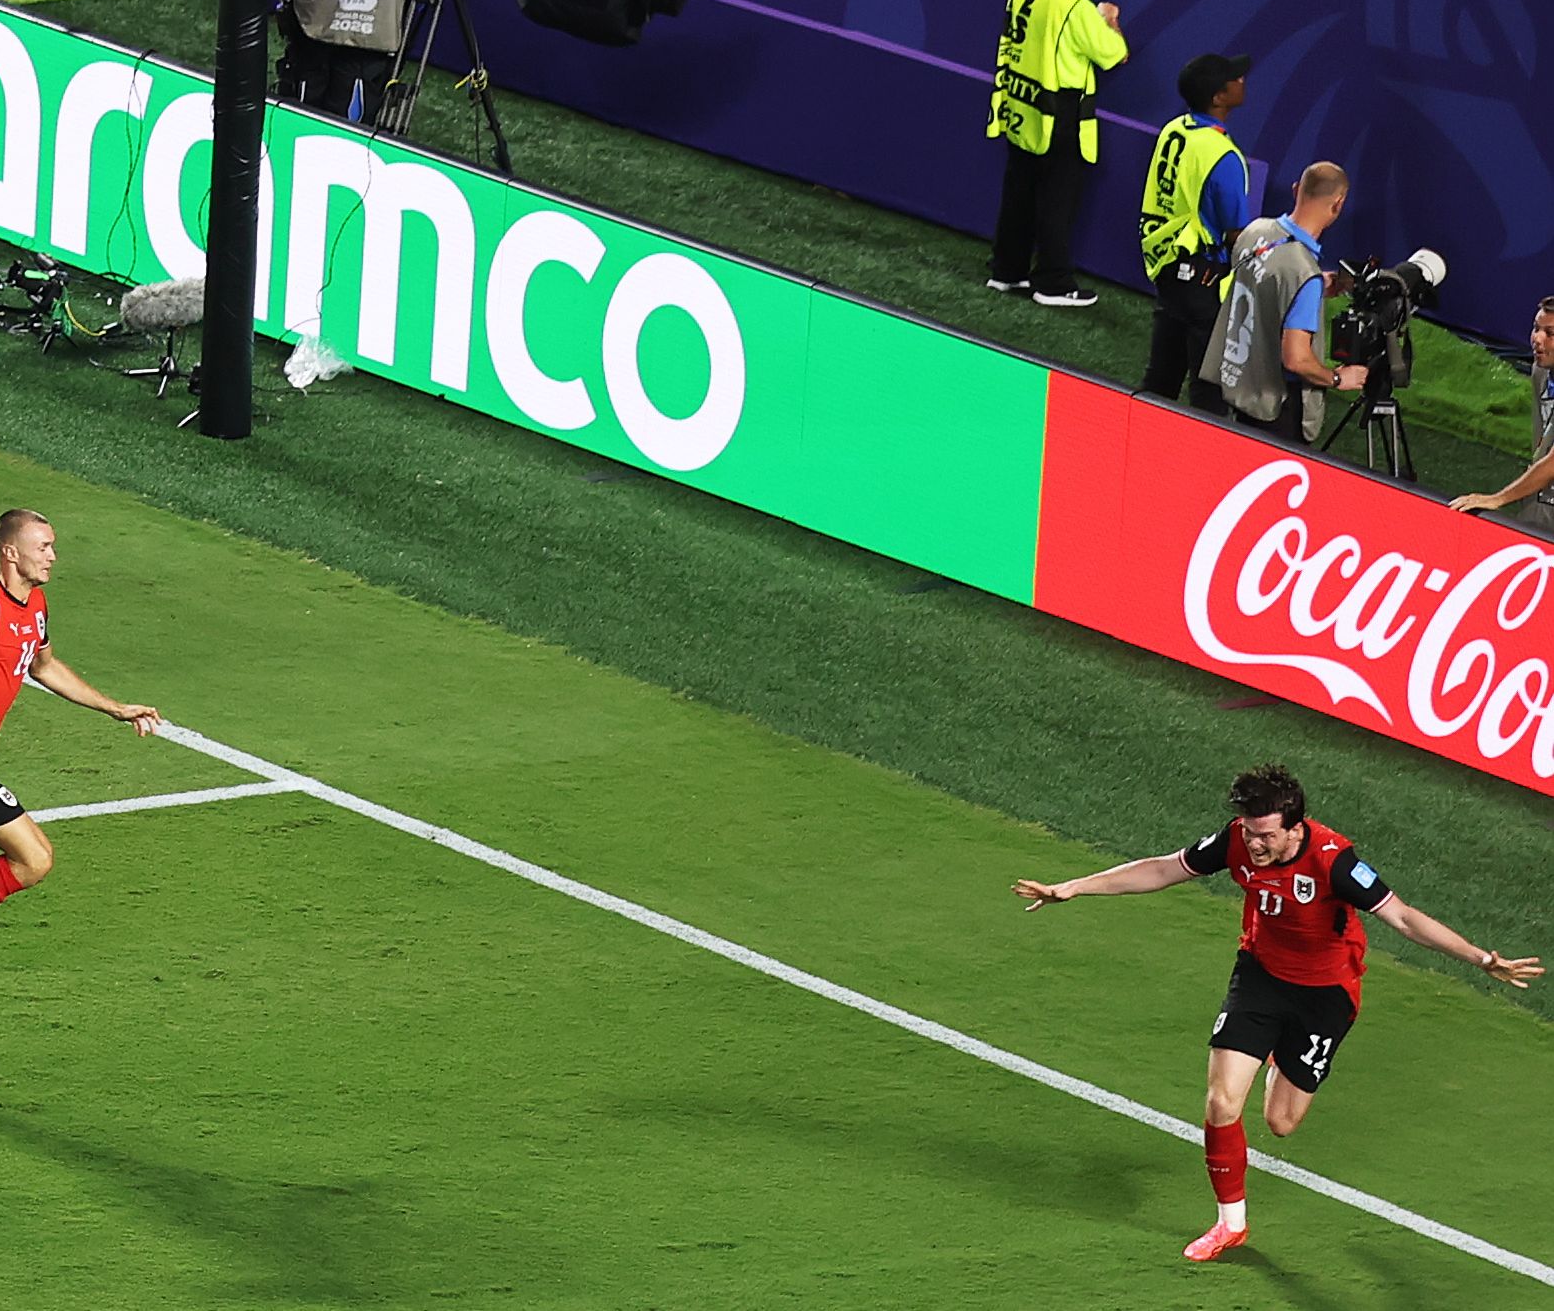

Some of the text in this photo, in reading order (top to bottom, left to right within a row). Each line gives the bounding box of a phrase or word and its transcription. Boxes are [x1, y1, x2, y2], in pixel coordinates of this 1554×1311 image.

[329, 19, 375, 35] 2026
[1184, 459, 1554, 779] Coca-Co
[1258, 888, 1284, 917] 11
[1299, 1033, 1334, 1071] 11
